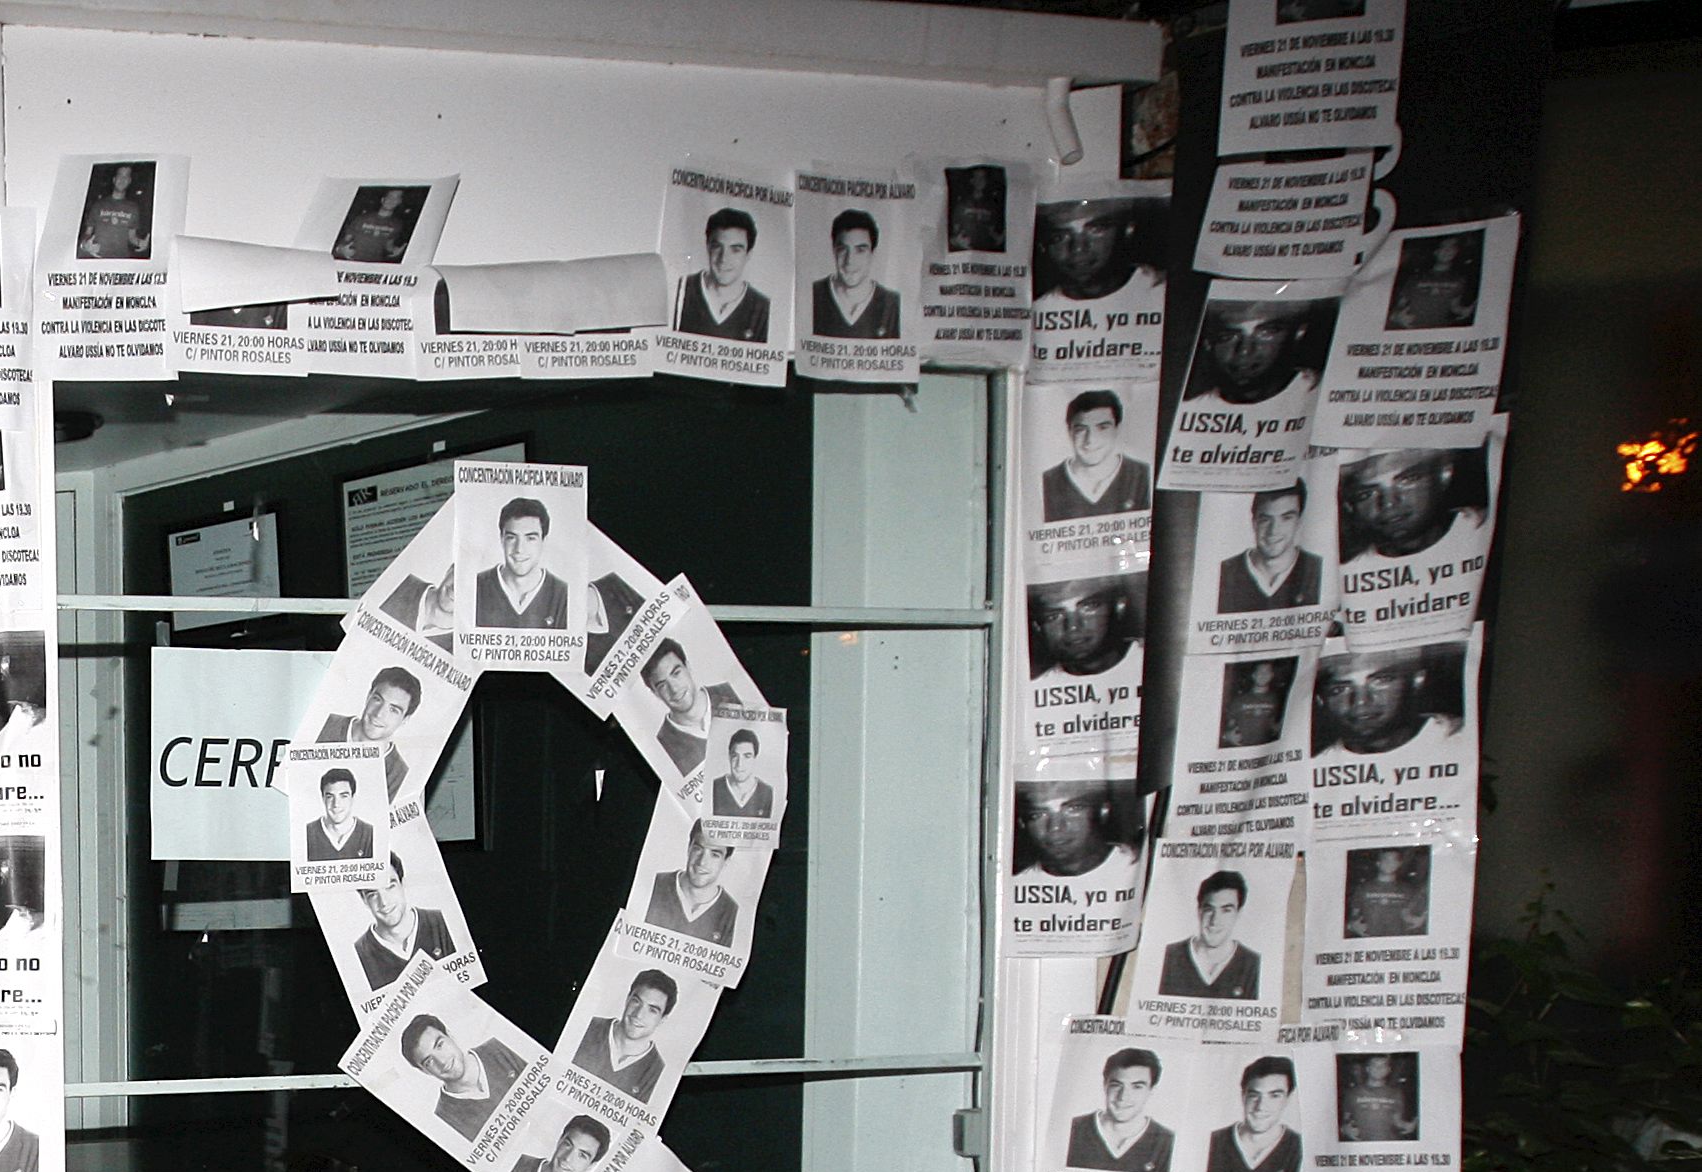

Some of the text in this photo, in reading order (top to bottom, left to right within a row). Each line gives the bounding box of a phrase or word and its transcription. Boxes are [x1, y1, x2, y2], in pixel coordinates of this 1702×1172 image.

[1033, 309, 1162, 331] USSIA, yo no
[656, 336, 784, 361] VIERNES 21, 20:00 HORAS
[1033, 338, 1161, 360] te olvidare...
[667, 351, 769, 374] C/ PINTOR ROSALES
[1179, 413, 1305, 438] USSIA, yo no
[1172, 445, 1295, 463] te olvidare...
[1344, 556, 1483, 594] USSIA, yo no
[1345, 591, 1470, 624] te olvidare
[460, 634, 583, 647] VIERNES 21, 20:00 HORAS
[471, 648, 570, 660] C/ PINTOR ROSALES
[1035, 685, 1128, 707] USSIA, yo
[1036, 714, 1142, 737] te olvidare
[19, 753, 41, 768] no
[1313, 762, 1458, 787] USSIA, yo no
[1314, 796, 1460, 819] te olvidare...
[1014, 885, 1135, 907] USSIA, yo no
[1014, 916, 1132, 932] te olvidare...
[16, 957, 40, 971] no
